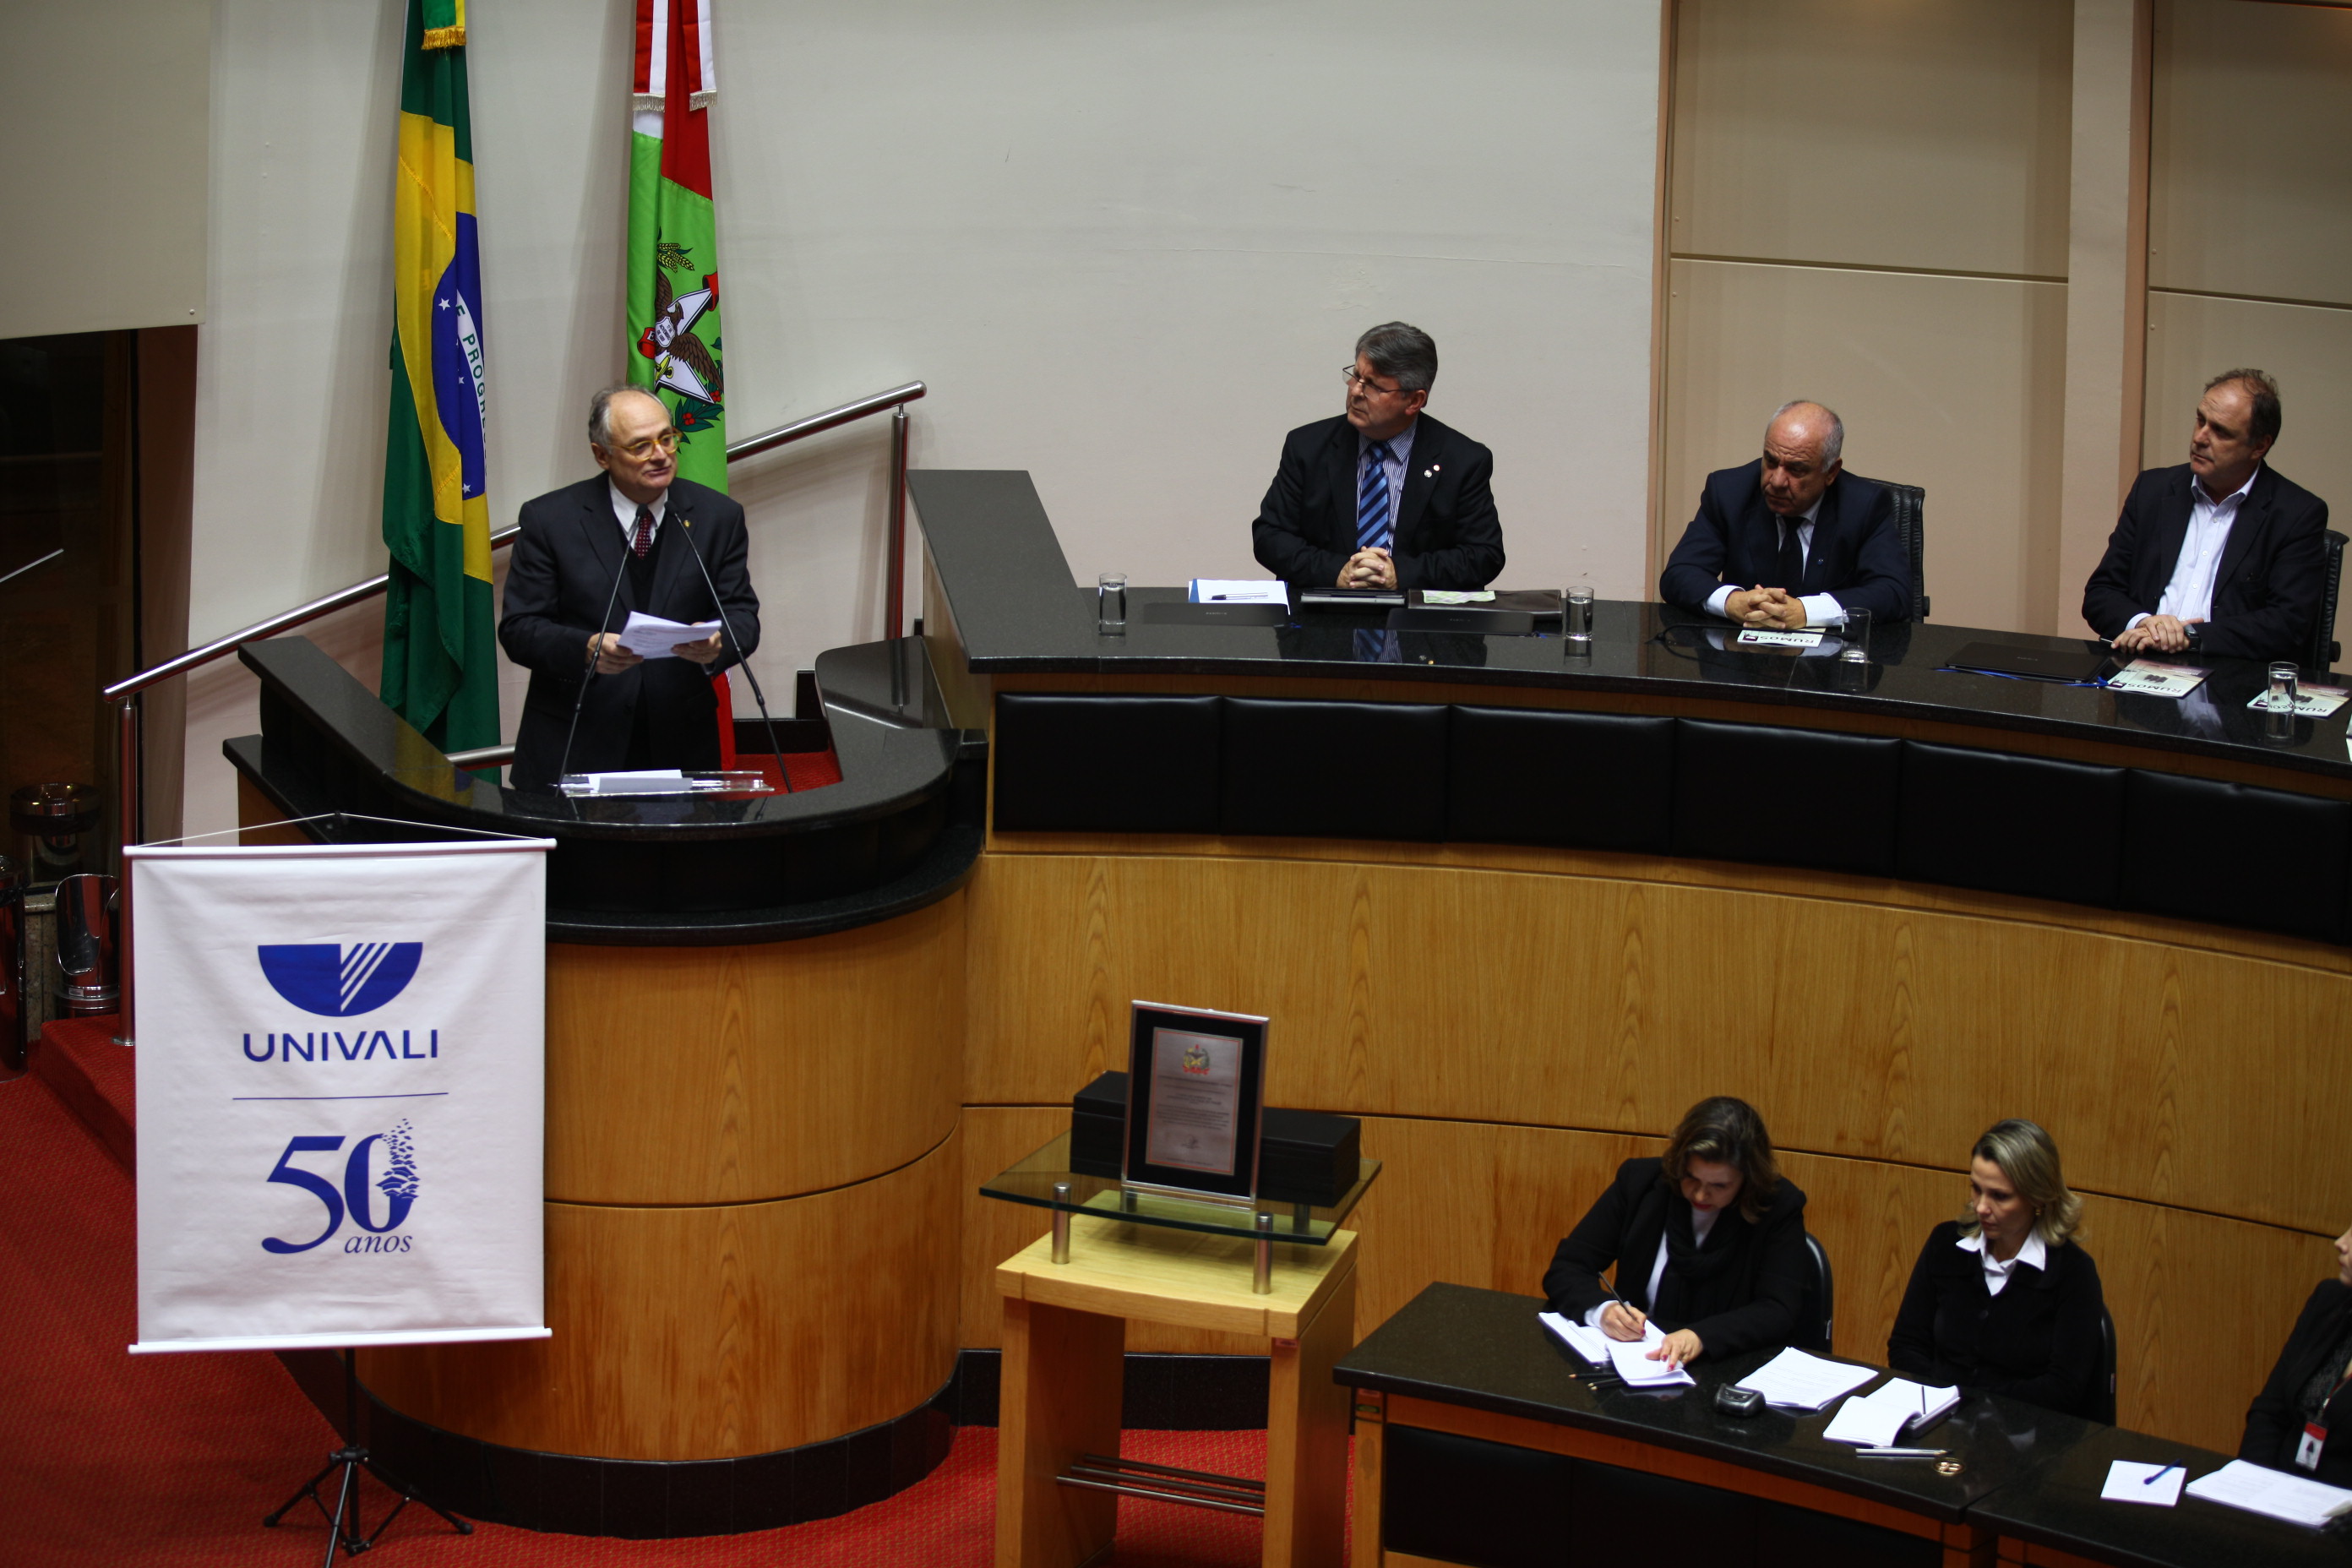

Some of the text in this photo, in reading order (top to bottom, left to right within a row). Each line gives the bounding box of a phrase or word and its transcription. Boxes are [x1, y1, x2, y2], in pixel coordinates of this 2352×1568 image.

[462, 333, 487, 476] PROGR
[2127, 683, 2181, 693] RUMOS
[243, 1029, 438, 1063] UNIVALI
[261, 1119, 421, 1255] 50
[344, 1234, 413, 1254] anos
